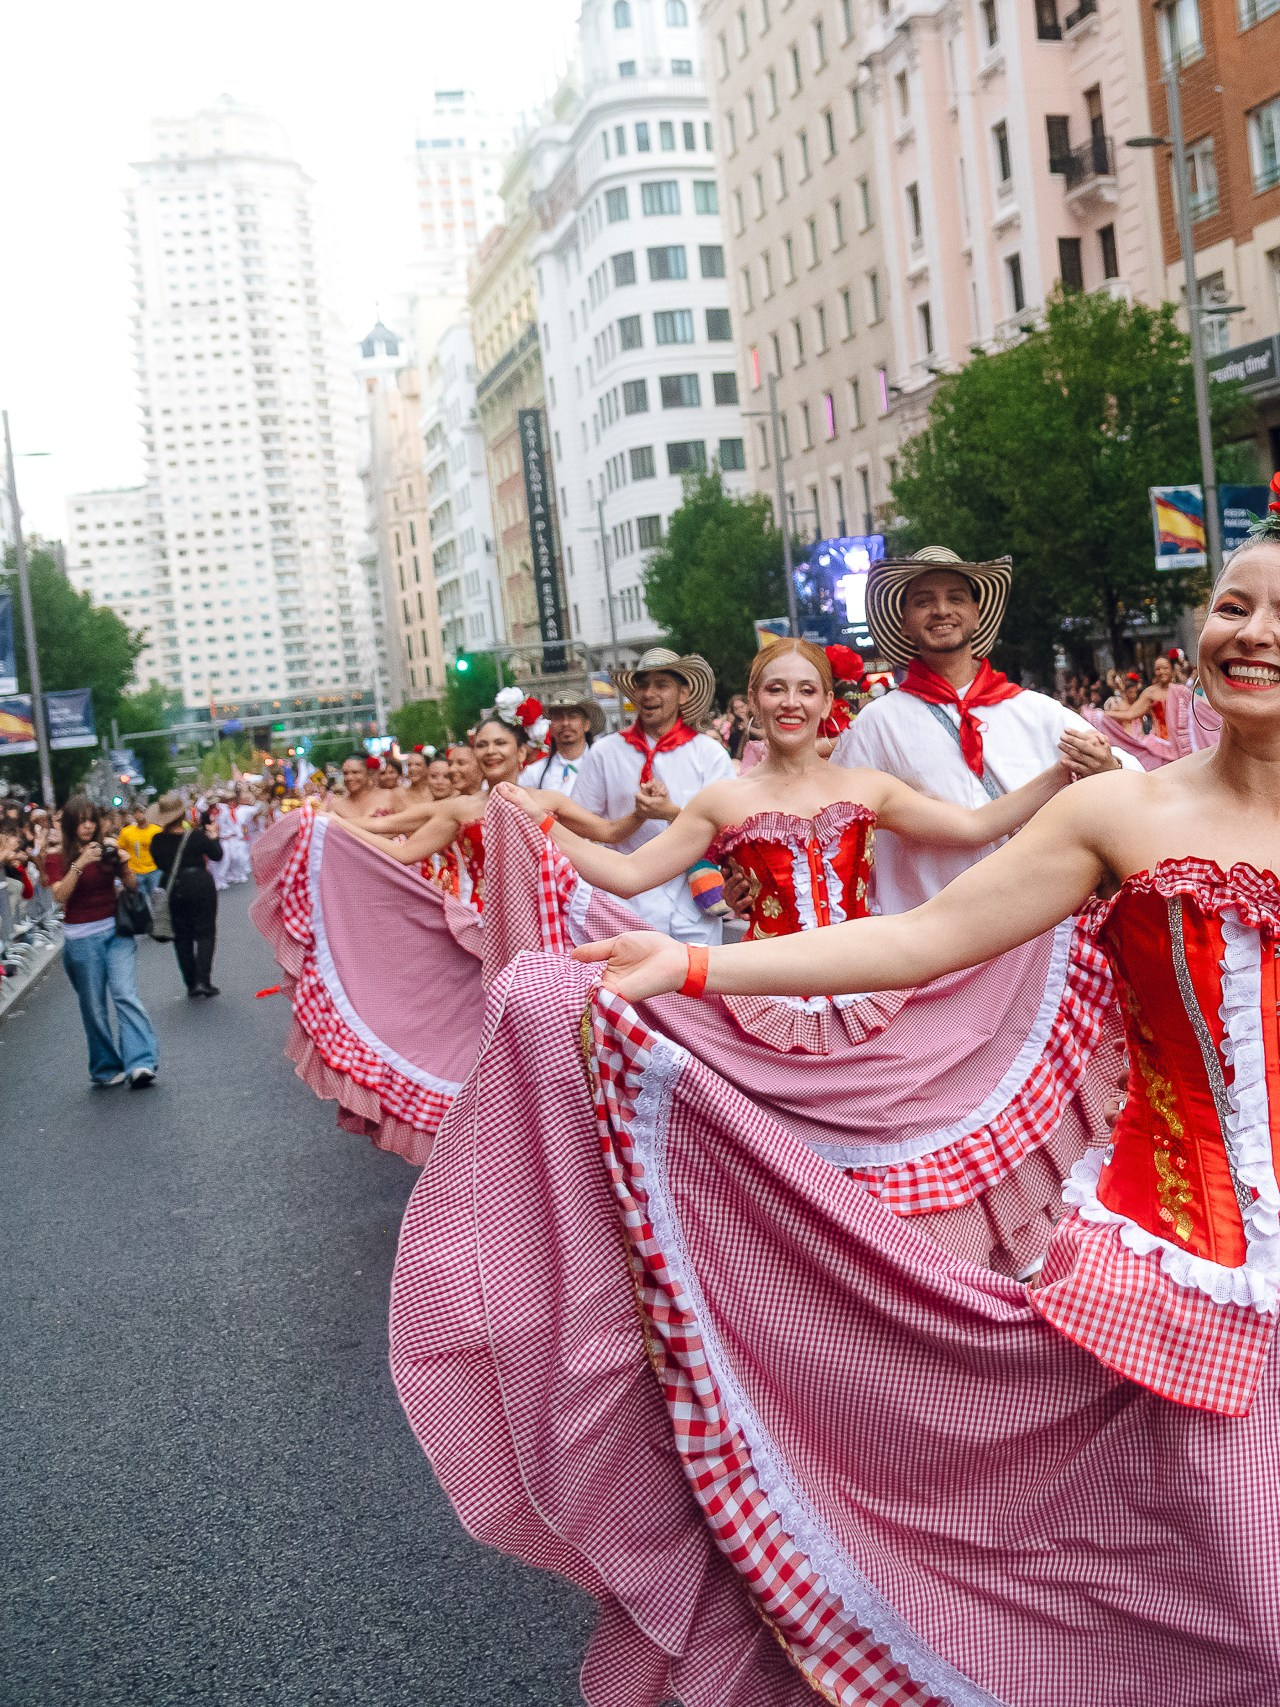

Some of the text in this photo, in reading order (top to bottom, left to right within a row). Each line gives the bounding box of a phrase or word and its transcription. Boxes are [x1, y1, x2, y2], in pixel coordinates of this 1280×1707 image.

[524, 415, 559, 640] CATALONIA PLAZA ESPAÑ
